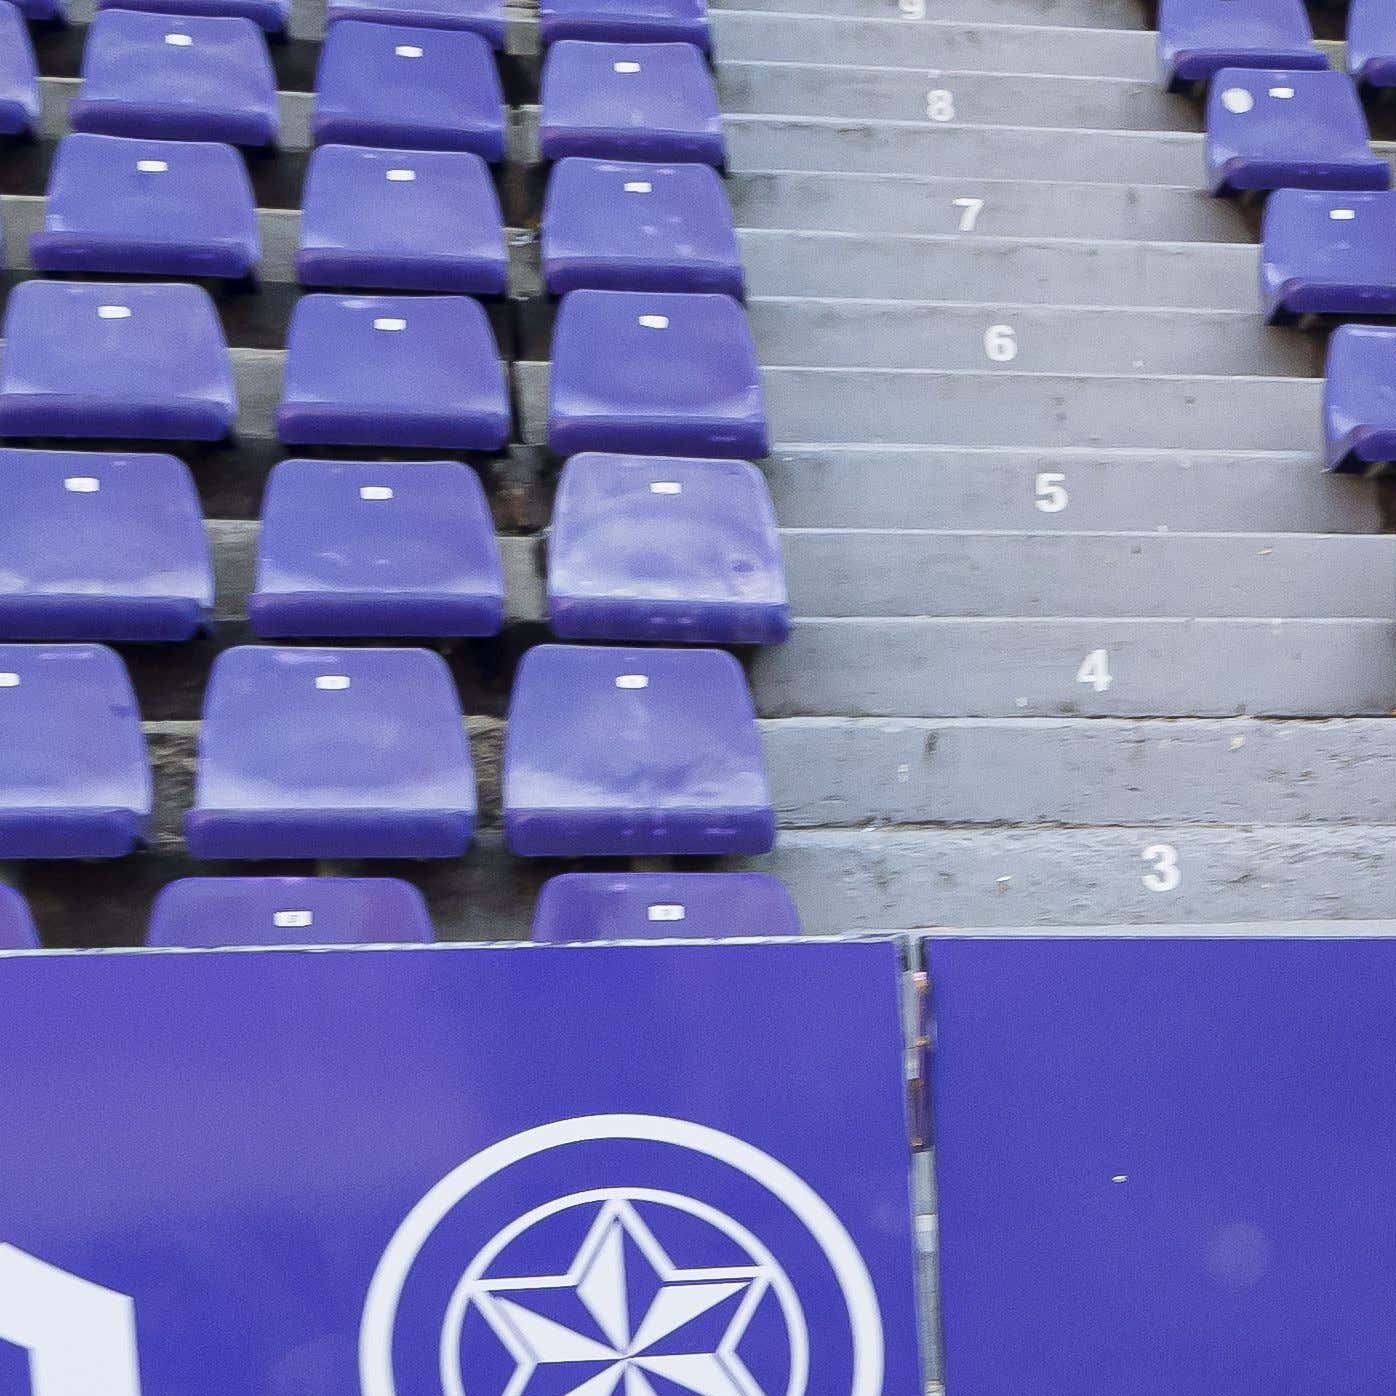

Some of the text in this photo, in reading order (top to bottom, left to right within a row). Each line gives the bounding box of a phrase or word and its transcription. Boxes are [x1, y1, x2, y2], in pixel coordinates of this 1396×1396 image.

[926, 89, 955, 122] 8
[952, 197, 985, 232] 7
[983, 324, 1017, 362] 6
[1035, 472, 1069, 513] 5
[1075, 648, 1113, 691] 4
[1141, 844, 1181, 892] 3
